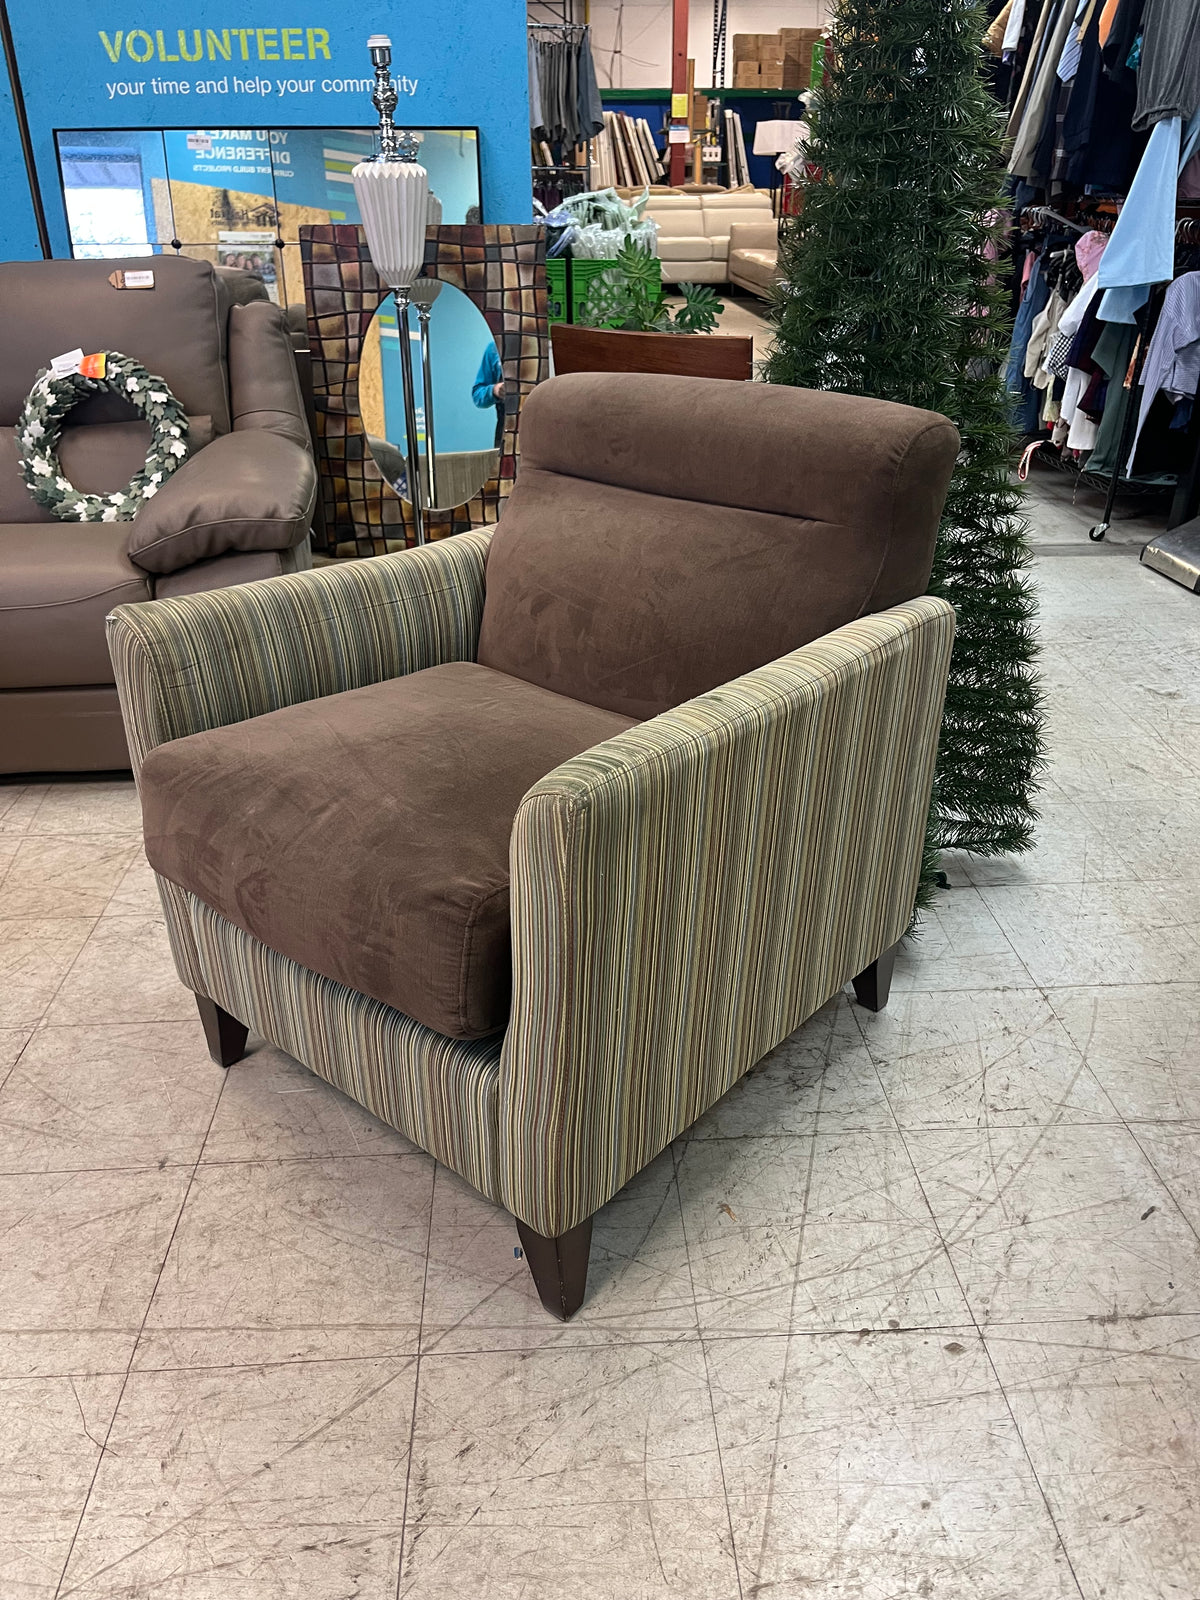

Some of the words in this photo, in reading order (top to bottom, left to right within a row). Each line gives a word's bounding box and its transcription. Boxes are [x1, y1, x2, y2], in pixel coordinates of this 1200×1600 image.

[98, 27, 331, 63] VOLUNTEER
[106, 79, 146, 100] your
[151, 77, 190, 95] time
[196, 76, 228, 94] and
[233, 75, 271, 97] help
[278, 78, 315, 97] your
[321, 74, 418, 96] commnity
